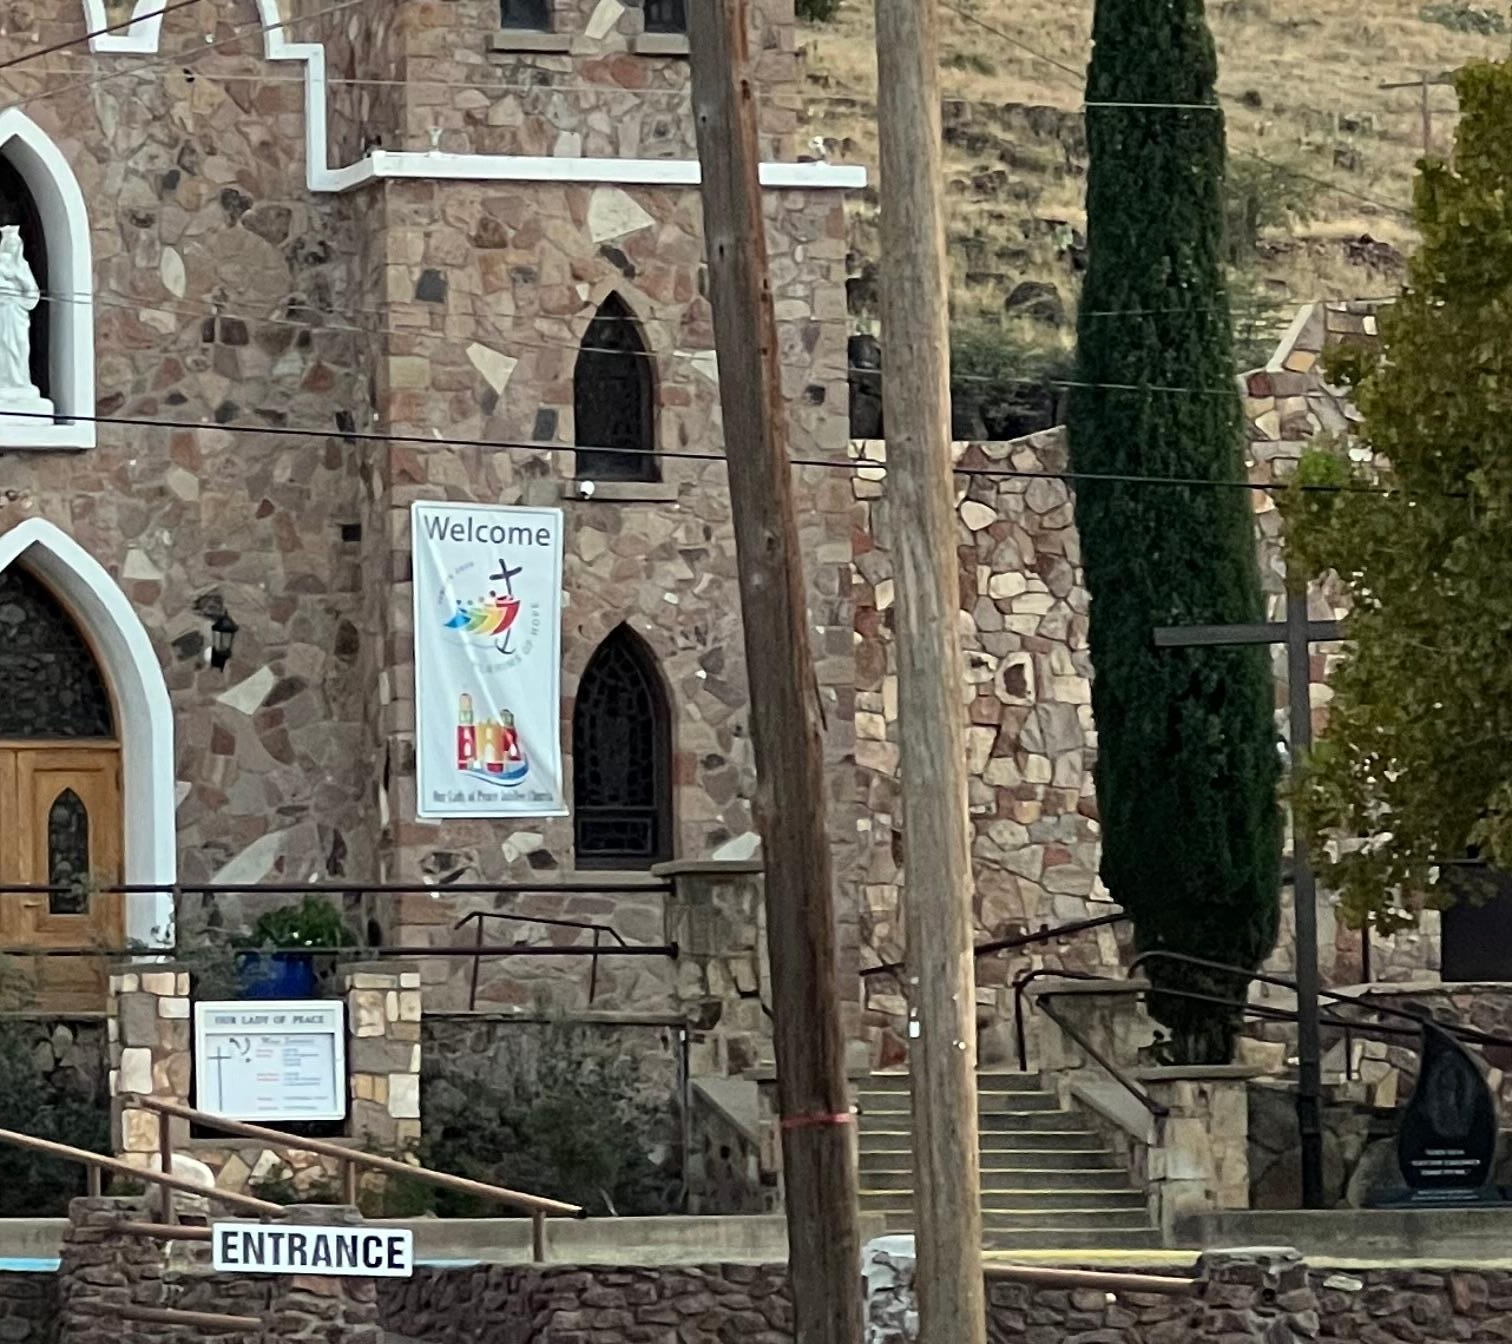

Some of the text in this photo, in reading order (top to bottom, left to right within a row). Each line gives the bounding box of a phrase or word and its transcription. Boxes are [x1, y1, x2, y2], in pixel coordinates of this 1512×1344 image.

[424, 515, 551, 546] Welcome
[214, 1015, 325, 1025] OUR LADY OF PEACE
[221, 1231, 405, 1269] ENTRANCE
